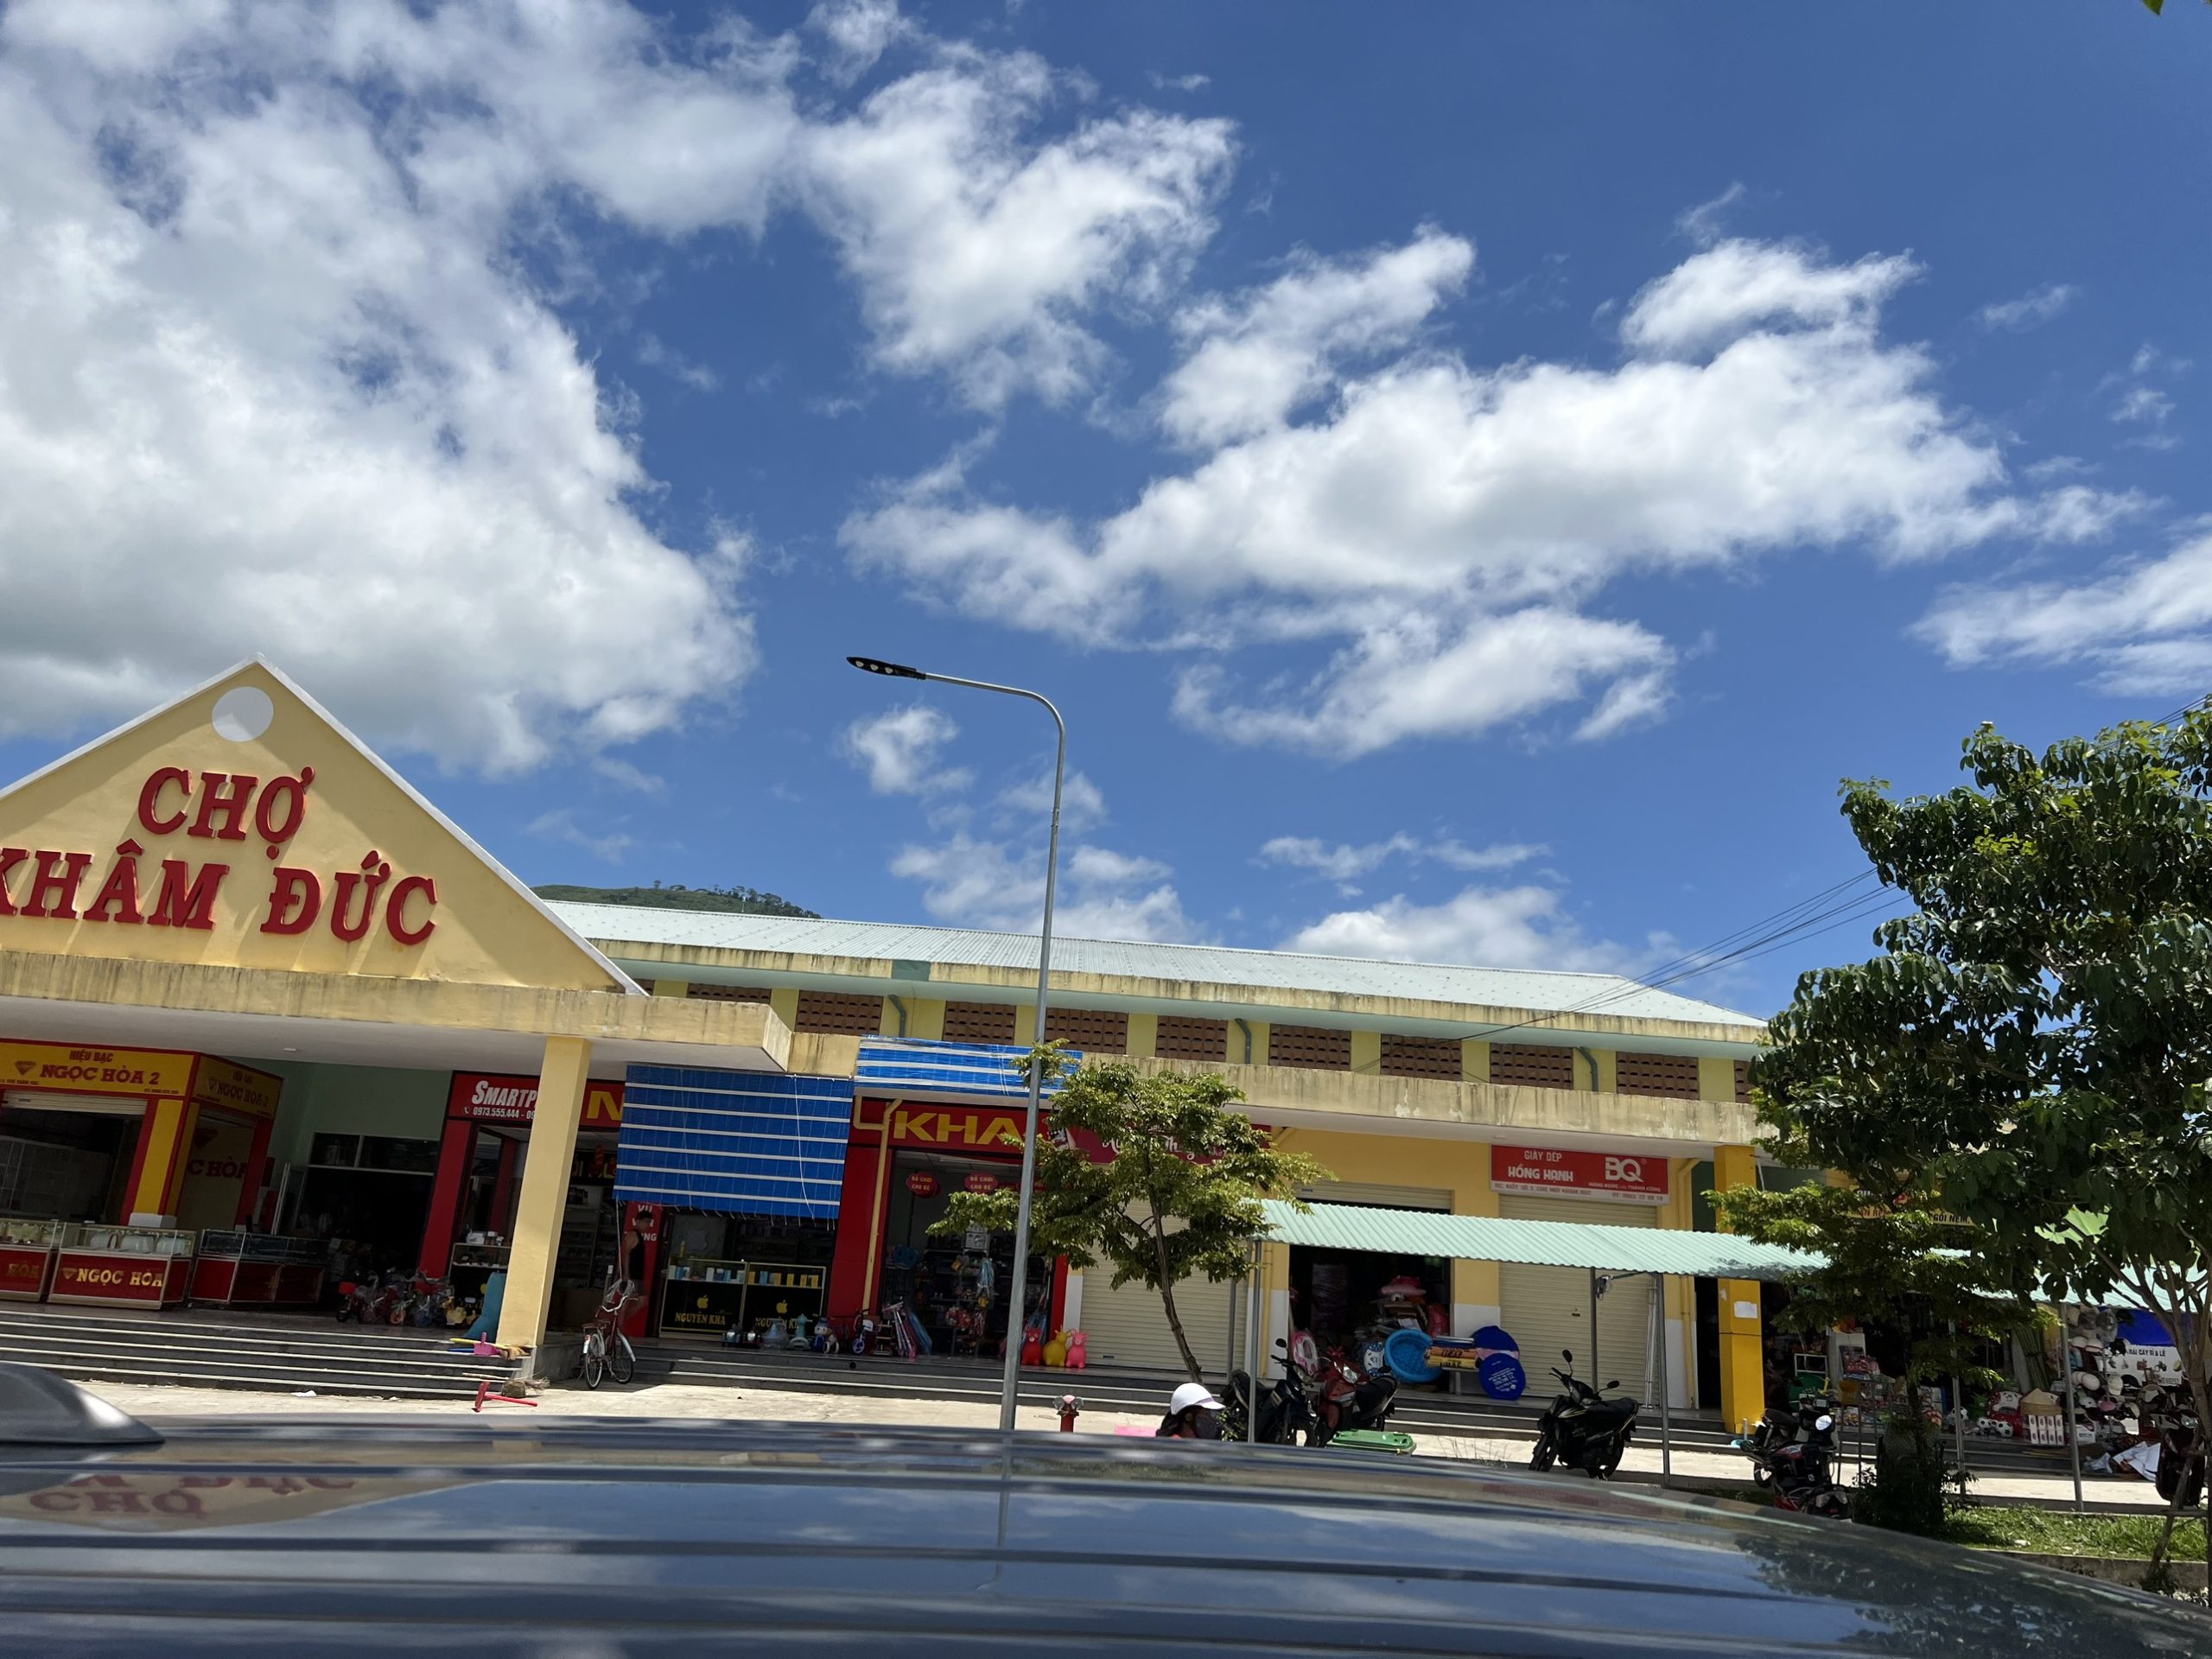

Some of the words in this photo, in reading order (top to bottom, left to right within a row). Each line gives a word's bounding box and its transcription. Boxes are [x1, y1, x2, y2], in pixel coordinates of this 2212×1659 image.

[138, 766, 315, 860] CHỢ
[260, 850, 438, 945] ĐỨC
[68, 1049, 91, 1063] HIỆU
[93, 1052, 114, 1064] BẠC
[40, 1064, 99, 1082] NGỌC
[100, 1065, 145, 1084] HÒA
[149, 1071, 160, 1084] 2
[472, 1080, 538, 1109] SMARTP
[1543, 1169, 1574, 1184] HẠNH
[1605, 1157, 1644, 1183] BQ
[76, 1268, 124, 1286] NGỌC
[129, 1268, 163, 1287] HÒA
[709, 1314, 726, 1325] KHA
